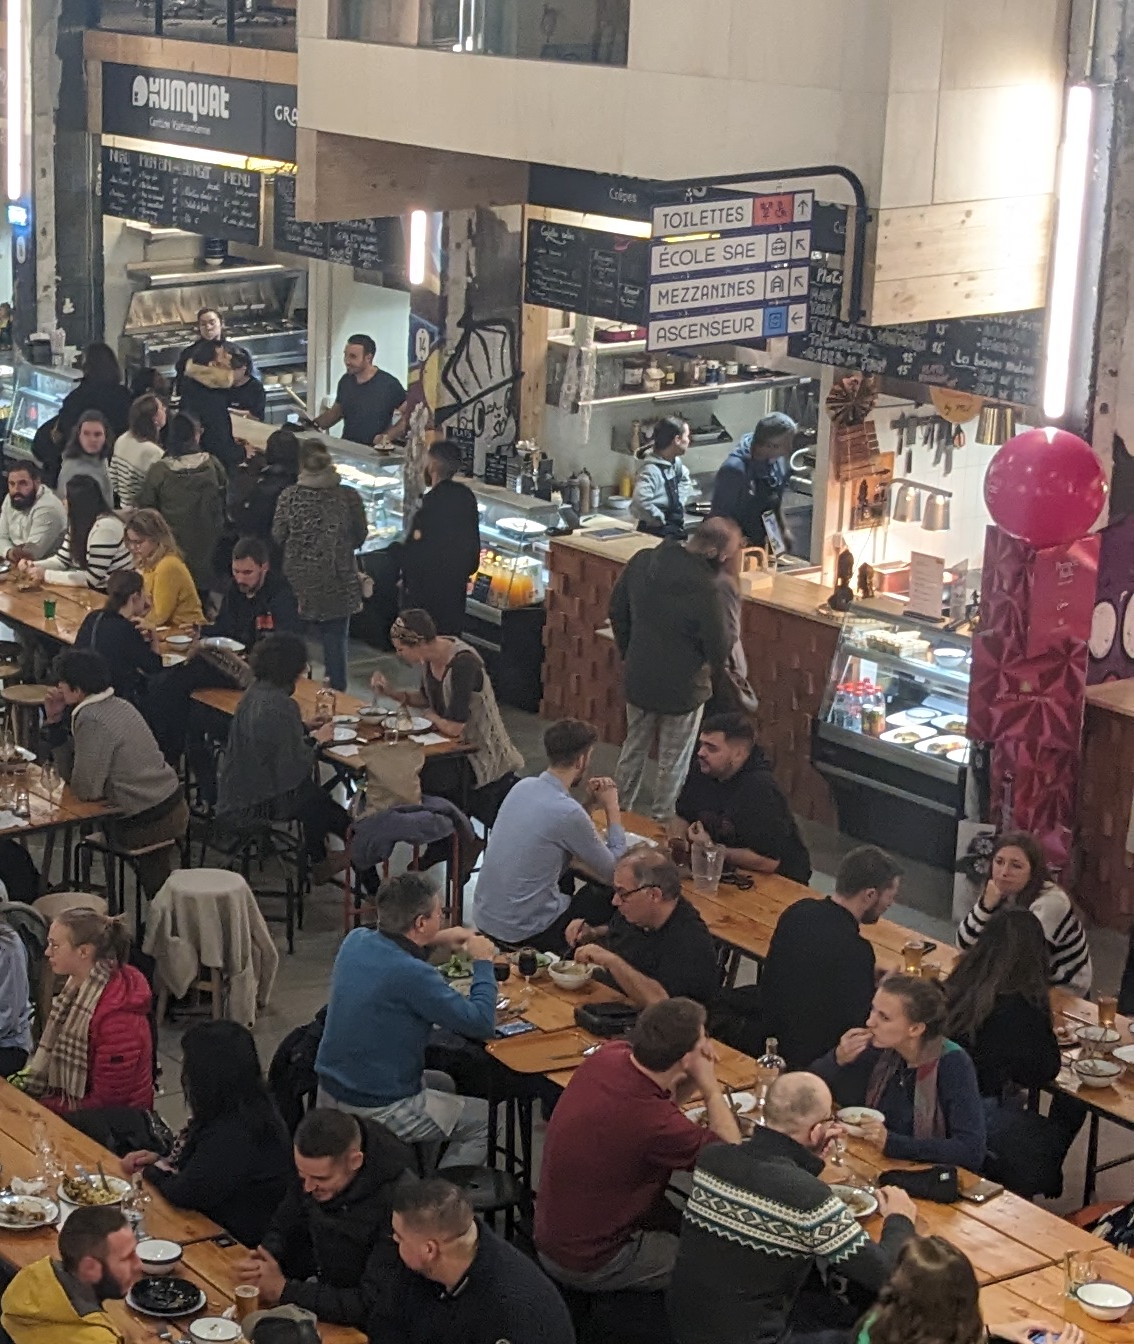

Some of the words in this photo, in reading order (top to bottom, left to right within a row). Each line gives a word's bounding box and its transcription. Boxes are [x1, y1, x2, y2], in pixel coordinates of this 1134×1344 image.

[662, 206, 744, 229] TOILETTES
[659, 246, 716, 268] ÉCOLE
[722, 242, 756, 261] SAE
[657, 280, 755, 305] MEZZANINES
[656, 317, 754, 344] ASCENSEUR
[418, 336, 426, 354] 14
